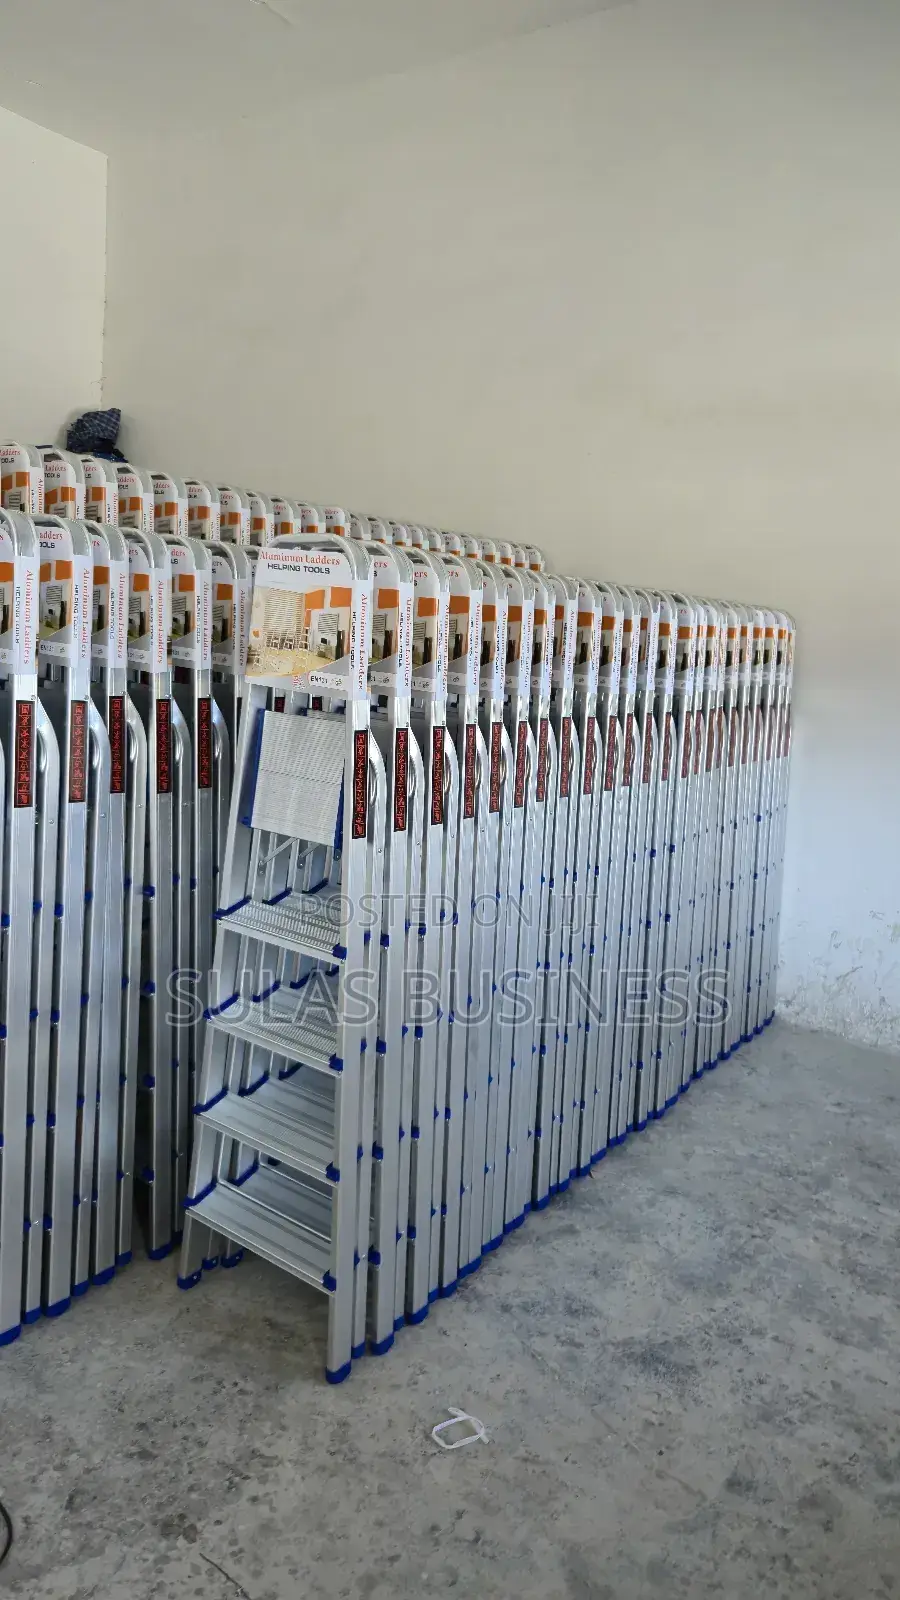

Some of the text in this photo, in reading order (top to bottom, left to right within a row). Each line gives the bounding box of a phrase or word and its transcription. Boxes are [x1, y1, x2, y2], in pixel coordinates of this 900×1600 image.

[40, 531, 63, 540] adders
[260, 551, 341, 566] Aluminum Ladders
[267, 562, 331, 575] HELPING TOOLS
[118, 573, 126, 620] Aluminum
[24, 569, 34, 664] Aluminum Ladders
[359, 593, 368, 647] Aluminum
[81, 620, 89, 659] Ladders
